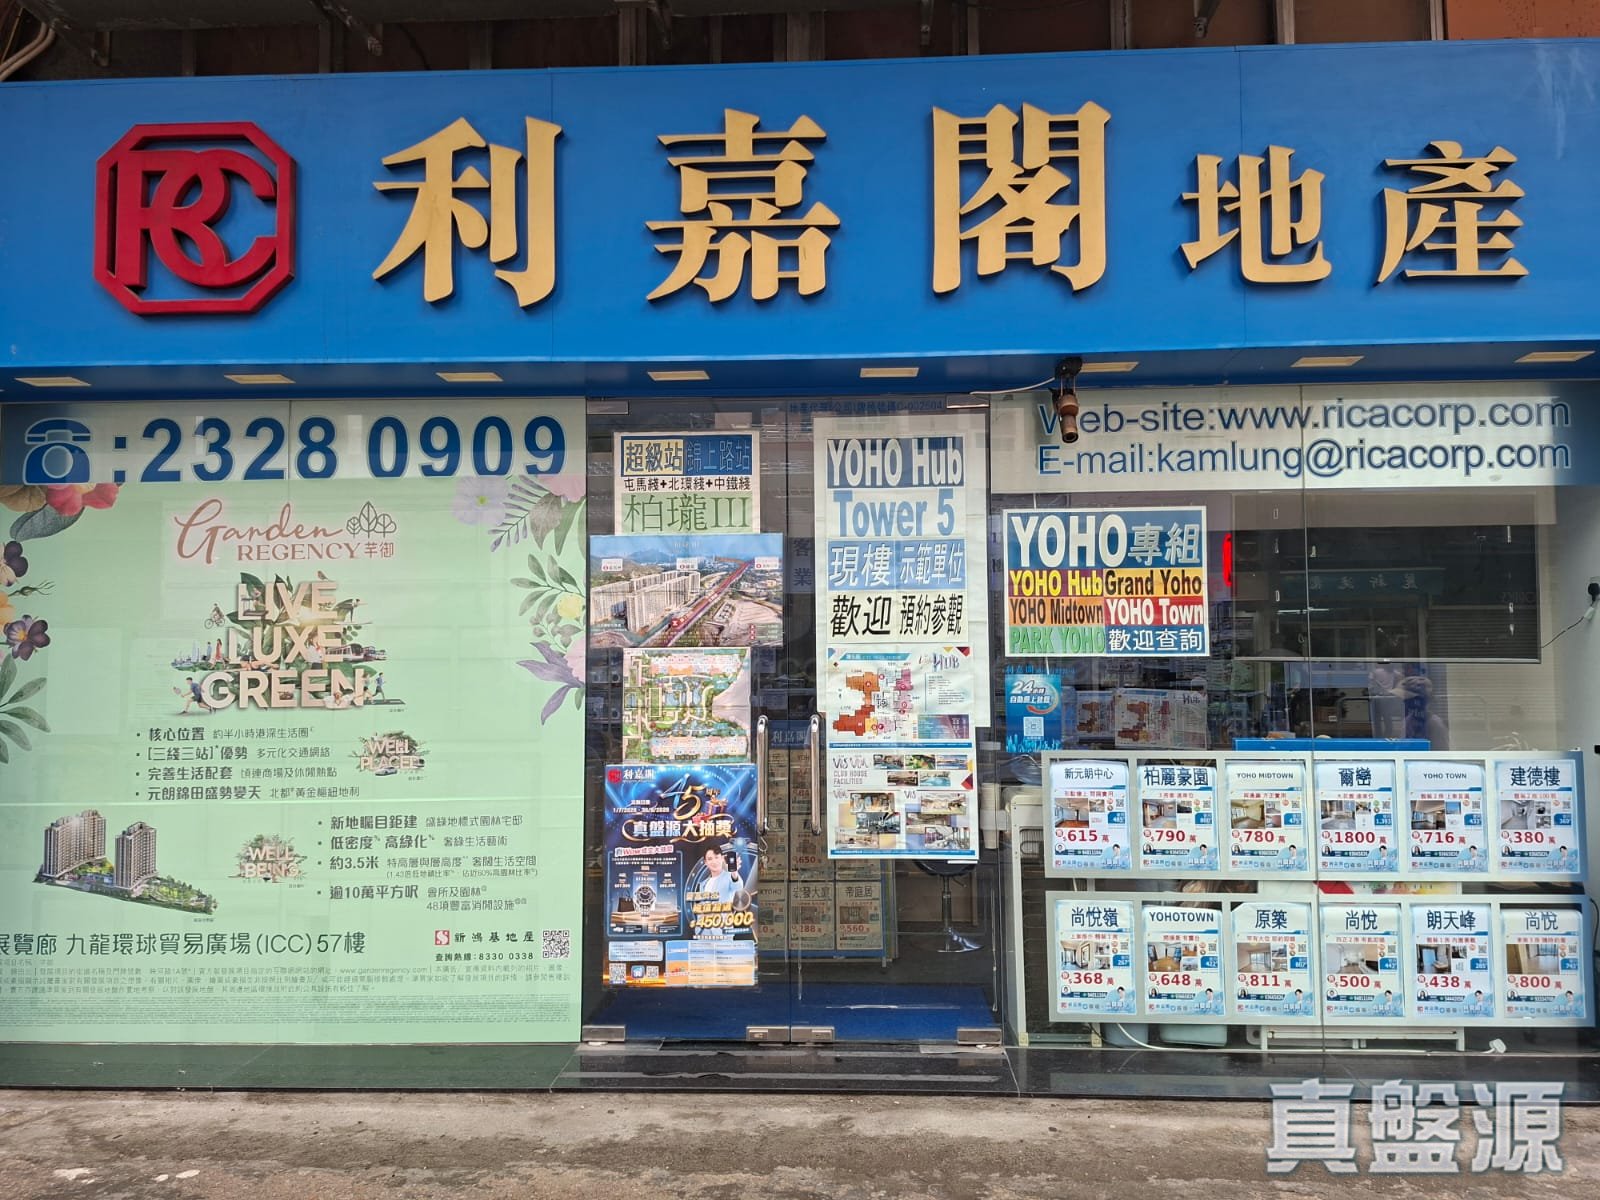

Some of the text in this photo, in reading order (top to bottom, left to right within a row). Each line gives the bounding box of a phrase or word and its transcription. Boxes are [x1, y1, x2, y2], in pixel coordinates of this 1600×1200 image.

[372, 101, 1528, 308] 利嘉閣地產
[368, 416, 566, 479] 0909
[625, 440, 750, 473] 超級站 錦上路站
[1039, 438, 1571, 478] E-mail:kamlung@ricacorp.com
[827, 437, 962, 487] YOHO Hub
[833, 488, 955, 538] Tower 5
[175, 498, 344, 564] Garden
[1011, 513, 1200, 568] YOHO專組
[237, 541, 394, 561] REGENCY 芊御
[829, 543, 963, 587] 現樓 示範單位
[1010, 570, 1103, 597] YOHO Hub
[1104, 569, 1202, 596] Grand Yoho
[237, 582, 338, 621] LIVE
[1010, 598, 1103, 625] YOHO Midtown
[1106, 597, 1204, 625] YOHO Town
[830, 593, 963, 638] 歡迎 預約參觀
[227, 624, 344, 664] LUXE
[1010, 627, 1105, 654] PARK YOHO
[1108, 629, 1202, 652] 歡迎查詢
[200, 668, 365, 709] GREEN
[149, 727, 205, 741] 核心位置
[148, 766, 233, 781] 完善生活配套
[1144, 767, 1208, 786] 柏麗豪園
[1510, 766, 1561, 786] 建德樓
[330, 856, 379, 870] 約3.5米
[329, 885, 419, 900] 逾10萬平方呎
[1071, 906, 1119, 928] 尚悅嶺
[1149, 911, 1214, 923] YOHOTOWN
[1255, 909, 1288, 930] 原築
[1345, 910, 1378, 931] 尚悅
[1427, 910, 1477, 931] 朗天峰
[1525, 911, 1559, 931] 尚悅
[508, 952, 534, 961] 0338
